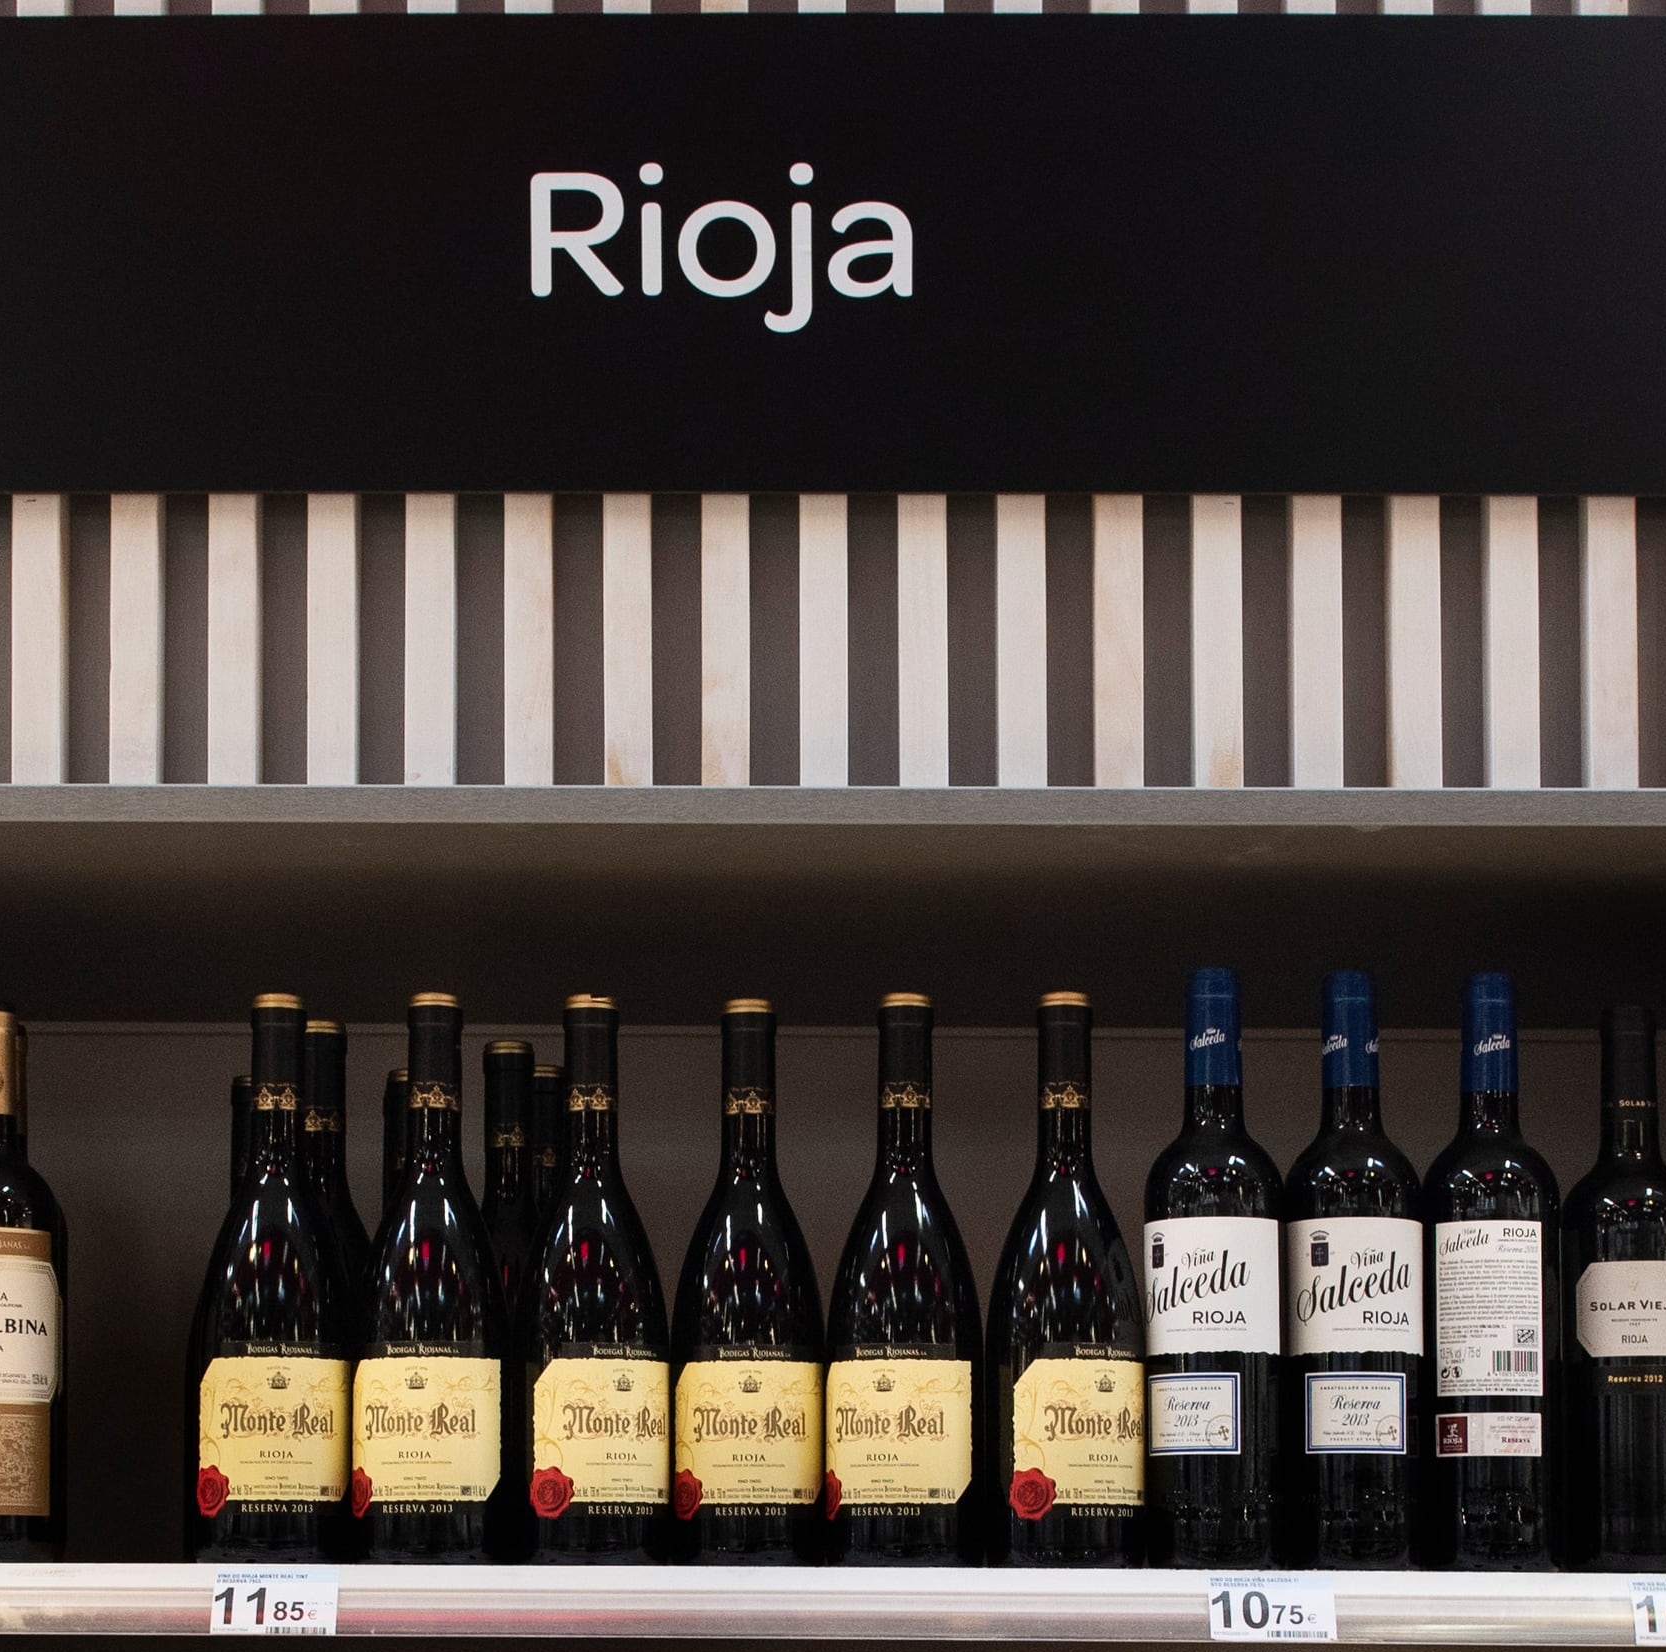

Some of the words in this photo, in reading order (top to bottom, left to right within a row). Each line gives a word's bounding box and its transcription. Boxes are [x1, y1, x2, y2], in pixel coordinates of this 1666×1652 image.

[530, 162, 913, 333] Rioja
[1297, 1249, 1413, 1324] Salceda
[1590, 1300, 1637, 1311] SOLAR
[1362, 1310, 1411, 1327] RIOJA
[365, 1402, 425, 1440] Monte
[430, 1403, 477, 1436] Real
[1329, 1395, 1382, 1414] Reserva
[214, 1587, 266, 1625] 11
[273, 1601, 305, 1621] 85
[1211, 1590, 1270, 1629] 10
[1272, 1605, 1304, 1625] 75
